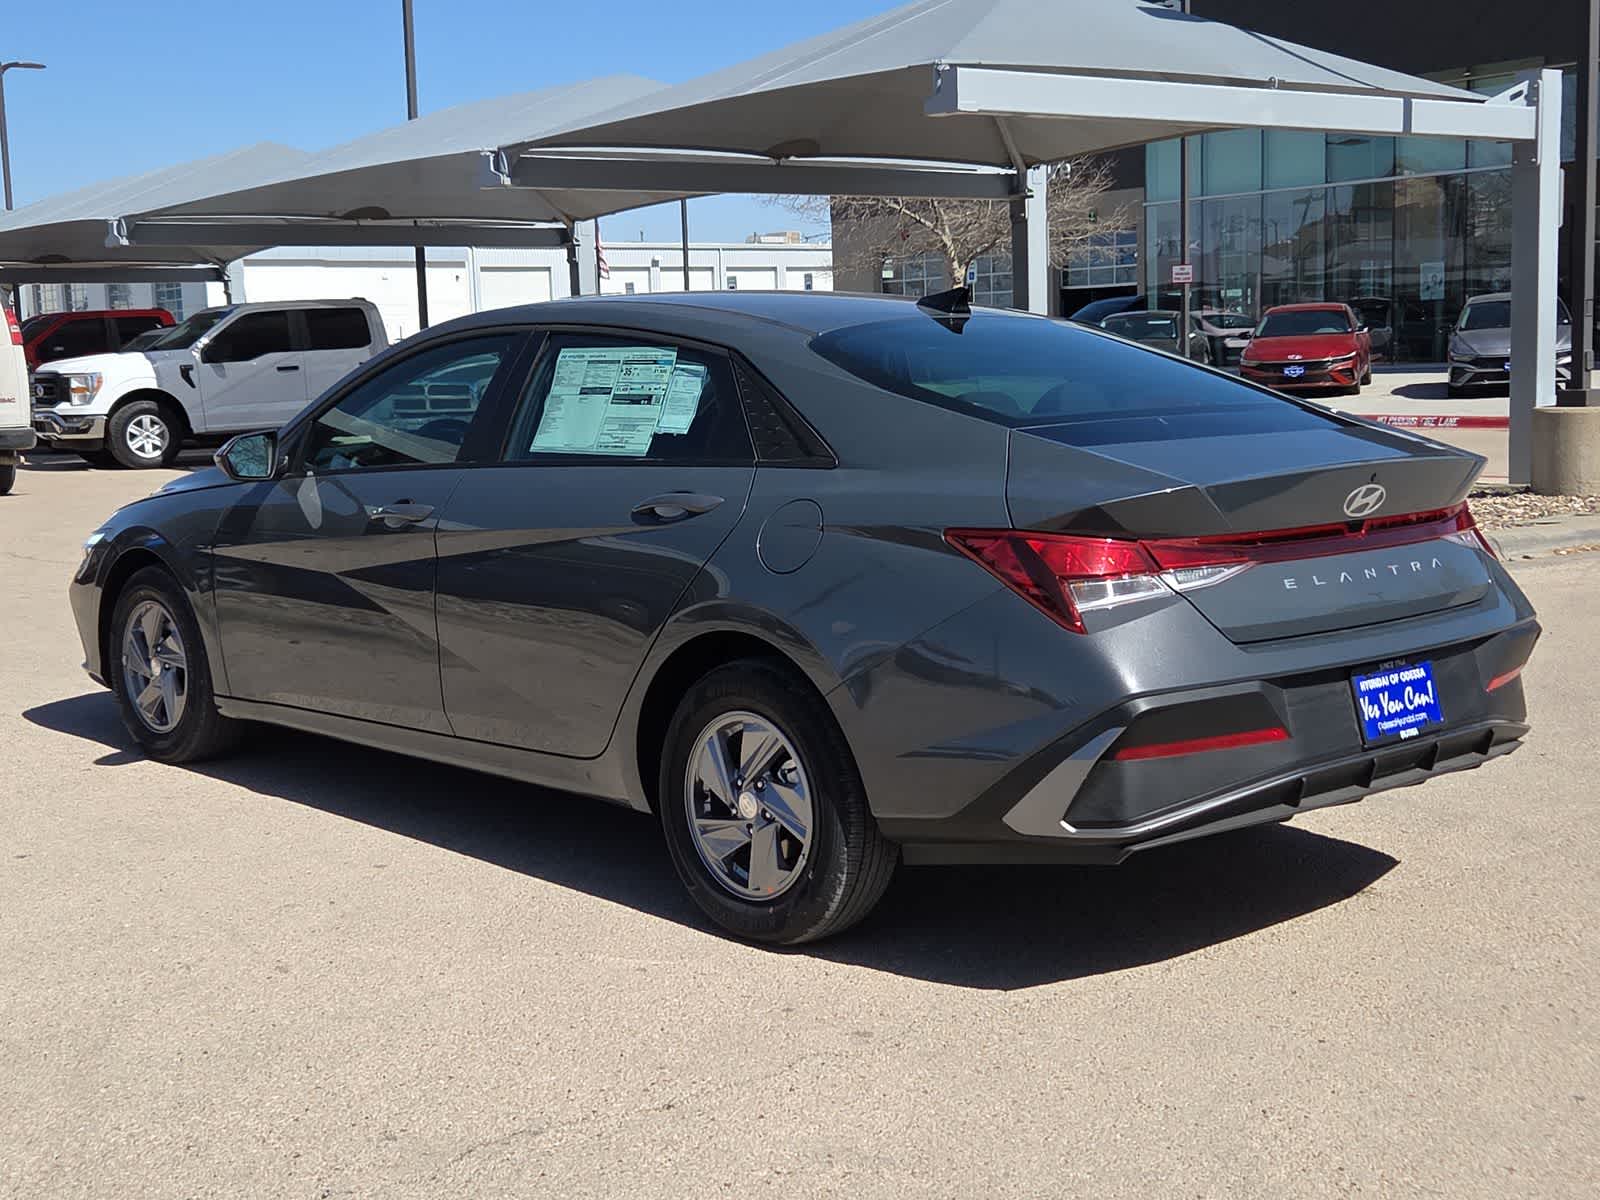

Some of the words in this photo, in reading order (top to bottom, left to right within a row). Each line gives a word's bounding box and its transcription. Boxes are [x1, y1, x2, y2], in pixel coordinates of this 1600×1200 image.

[1438, 417, 1460, 427] LANE
[1283, 557, 1443, 590] ELANTRA
[1359, 675, 1390, 692] HYUNDAI
[1389, 673, 1400, 685] OF
[1400, 667, 1427, 682] ODESSA
[1359, 695, 1381, 722] Yes
[1379, 691, 1404, 716] You
[1404, 679, 1434, 710] Can!
